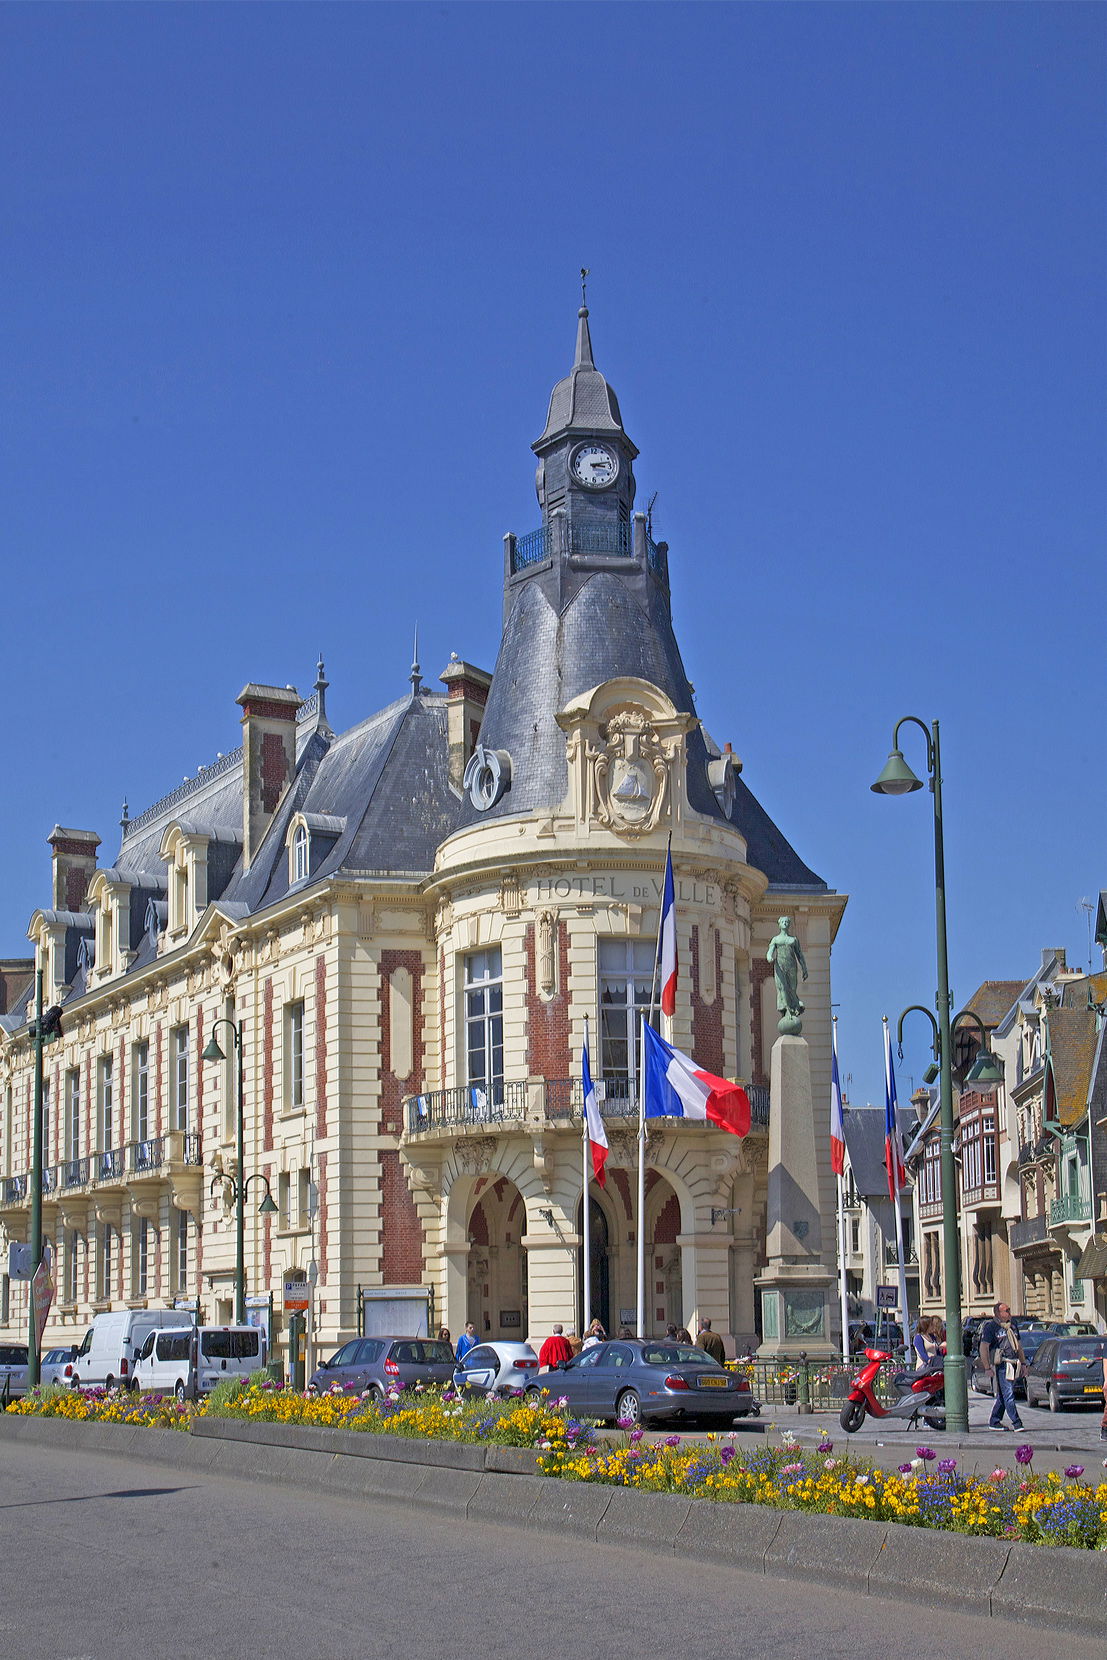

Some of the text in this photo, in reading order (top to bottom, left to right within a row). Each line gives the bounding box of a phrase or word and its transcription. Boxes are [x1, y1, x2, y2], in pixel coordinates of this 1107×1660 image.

[536, 876, 716, 905] HOTEL DE VLLE
